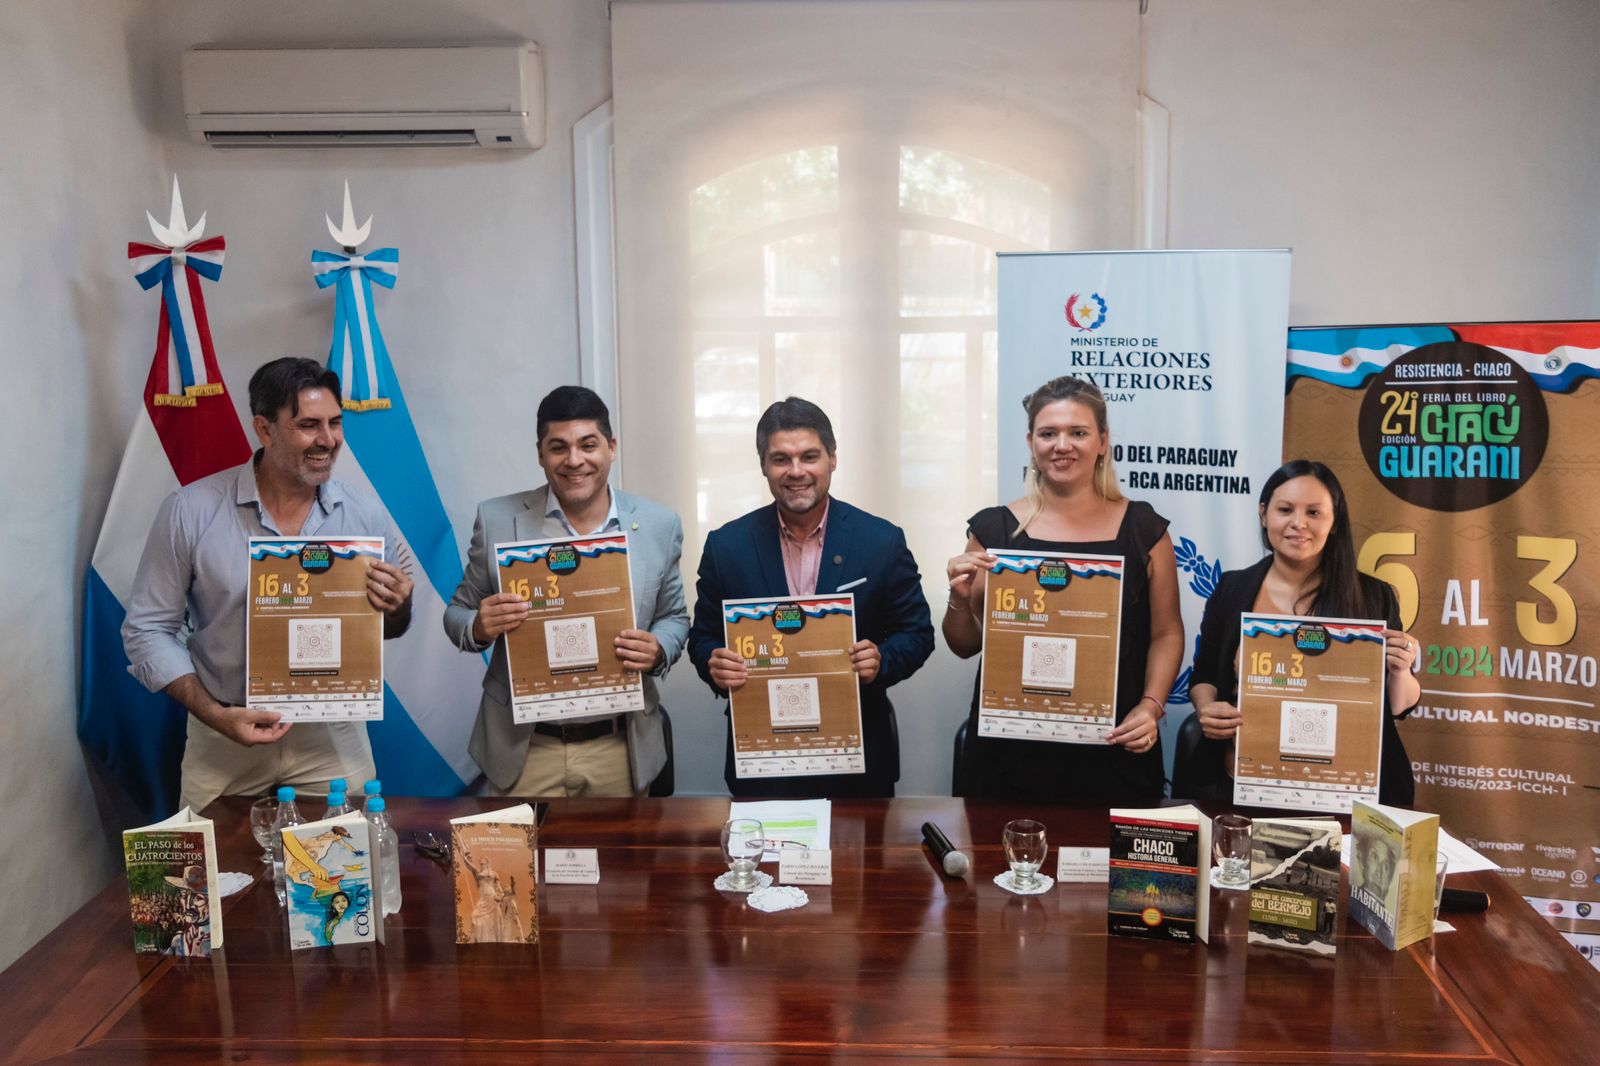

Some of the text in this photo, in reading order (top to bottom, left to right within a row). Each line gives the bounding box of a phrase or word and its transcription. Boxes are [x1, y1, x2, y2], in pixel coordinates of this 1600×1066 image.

[1070, 337, 1159, 348] MINISTERIO DE
[1070, 350, 1211, 370] RELACIONES
[1395, 363, 1463, 379] RESISTENCIA
[1474, 362, 1511, 377] CHACO
[1103, 393, 1136, 403] GUAY
[1423, 392, 1507, 403] FERIA DEL LIBRO
[1381, 434, 1417, 444] EDICIÓN
[1127, 445, 1154, 463] DEL
[1157, 446, 1238, 468] PARAGUAY
[1129, 471, 1160, 490] RCA
[1163, 472, 1251, 494] ARGENTINA
[258, 573, 310, 597] 16 AL 3
[509, 578, 531, 602] 16
[534, 587, 544, 597] AL
[546, 575, 560, 598] 3
[1441, 579, 1489, 627] AL
[1516, 535, 1577, 646] 3
[255, 596, 280, 605] FEBRERO
[293, 596, 313, 605] MARZO
[546, 598, 565, 606] MARZO
[995, 588, 1047, 613] 16 AL 3
[991, 610, 1016, 620] FEBRERO
[735, 634, 785, 658] 16 AL 3
[1250, 651, 1305, 678] 16 AL 3
[1426, 644, 1598, 688] 2024 MARZO
[1247, 675, 1273, 685] FEBRERO
[1287, 678, 1308, 687] MARZO
[1406, 705, 1499, 723] ULTURAL
[1411, 761, 1575, 784] DE INTERÉS CULTURAL
[134, 840, 195, 850] EL PASO de los
[1133, 838, 1174, 855] CHACO
[1479, 840, 1525, 851] errepar
[1536, 844, 1577, 855] riverside
[127, 852, 203, 861] CUATROCIENTOS
[1128, 852, 1179, 864] HISTORIA GENERAL
[1531, 867, 1566, 879] OCEANO
[1251, 899, 1312, 917] del BERMEJO
[1351, 884, 1393, 929] HABITANTE
